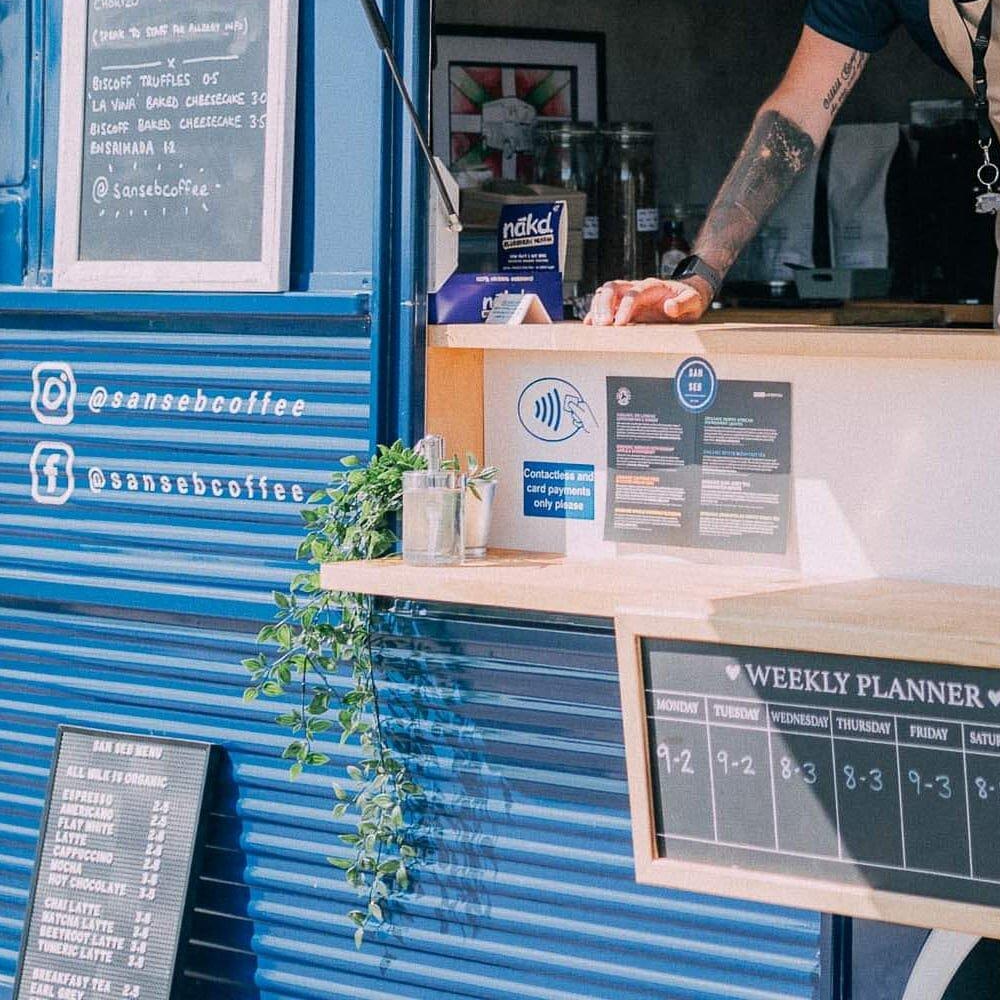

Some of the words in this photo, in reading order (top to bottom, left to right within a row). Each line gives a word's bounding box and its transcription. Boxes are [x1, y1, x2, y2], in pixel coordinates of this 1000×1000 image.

[92, 74, 132, 91] BISCOFF
[139, 72, 190, 87] TRUFFLES
[146, 96, 179, 110] BAKED
[185, 92, 245, 108] CHEESECAKE
[89, 121, 130, 136] BISCOFF
[137, 117, 172, 132] BAKED
[179, 115, 243, 130] CHEESECAKE
[688, 368, 704, 378] SAN
[688, 382, 703, 392] SEB
[88, 386, 306, 417] @sansebcoffee
[523, 467, 576, 481] Contactless
[577, 471, 594, 482] and
[88, 466, 304, 502] @sansebcoffee
[526, 483, 546, 494] card
[548, 485, 591, 497] payments
[533, 497, 553, 511] only
[554, 499, 584, 512] please
[745, 662, 850, 695] WEEKLY
[856, 672, 985, 709] PLANNER
[656, 698, 700, 715] MONDAY
[713, 703, 761, 721] TUESDAY
[771, 710, 830, 729] WEDNESDAY
[836, 717, 891, 736] THURSDAY
[909, 724, 949, 742] FRIDAY
[66, 765, 86, 779] ALL
[124, 772, 169, 789] ORGANIC
[656, 743, 695, 775] 9-2
[716, 750, 756, 776] 9-2
[843, 765, 883, 791] 8-3
[908, 769, 952, 799] 9-3
[68, 900, 102, 917] LATTE
[82, 917, 115, 934] LATTE
[91, 933, 125, 951] LATTE
[79, 946, 114, 963] LATTE
